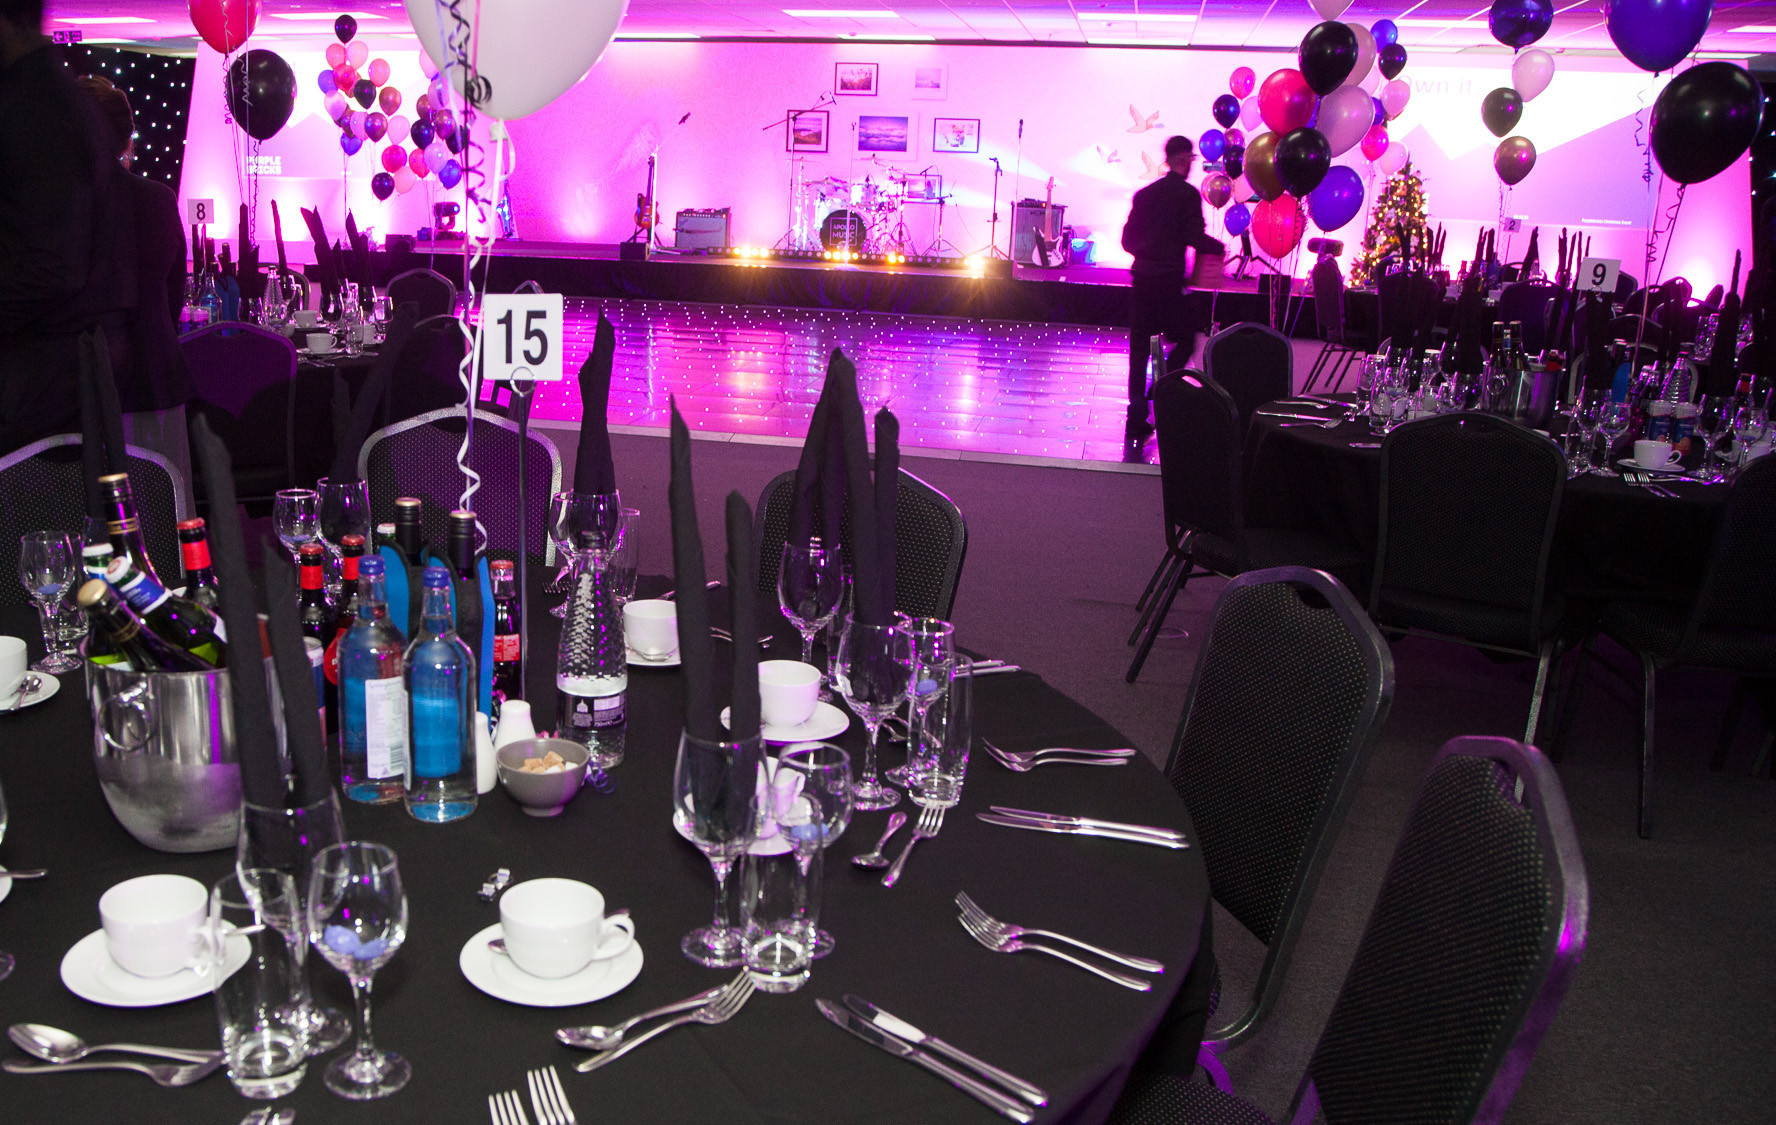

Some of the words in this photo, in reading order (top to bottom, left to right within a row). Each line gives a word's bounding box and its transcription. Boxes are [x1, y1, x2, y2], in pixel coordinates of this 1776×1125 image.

[246, 156, 281, 165] PURPLE
[246, 165, 282, 175] BRICKS
[196, 202, 206, 220] 8
[1509, 220, 1516, 230] 2
[832, 231, 855, 239] MUSC
[1591, 262, 1607, 286] 9
[497, 309, 548, 366] 15
